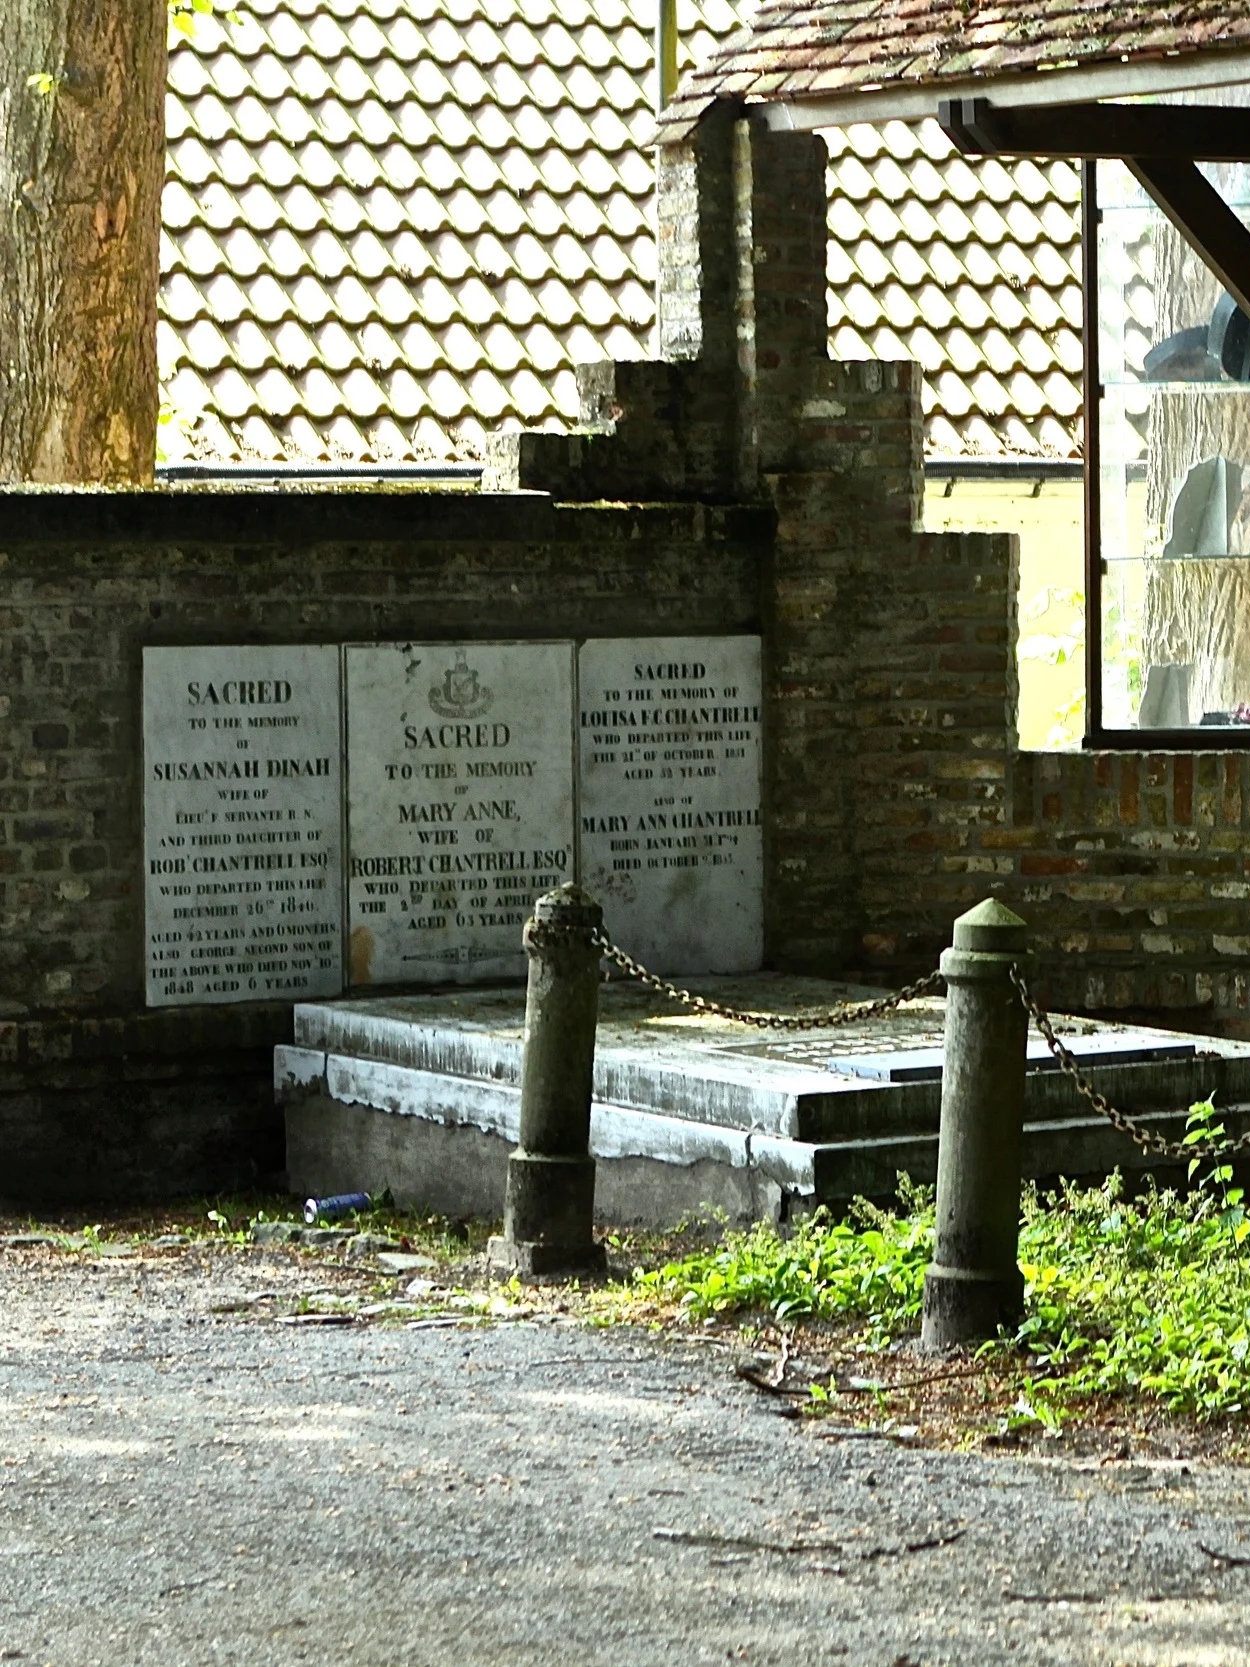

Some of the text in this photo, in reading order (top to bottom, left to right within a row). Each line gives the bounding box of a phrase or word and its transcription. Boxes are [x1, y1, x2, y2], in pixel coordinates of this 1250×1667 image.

[634, 662, 706, 680] SACRED
[187, 680, 293, 706] SACRED
[603, 687, 739, 702] TO THE MEMORY OF
[188, 716, 300, 730] TO THE MEMORY
[581, 707, 759, 728] LOUISA CHANTRELL
[236, 739, 250, 749] OF
[404, 723, 510, 749] SACRED
[593, 730, 750, 745] WHO DEPARTED THIS LIFE
[592, 752, 616, 763] THE
[643, 751, 658, 761] OF
[153, 758, 330, 782] SUSANNAH DINAH
[385, 761, 537, 781] TO THE MEMORY
[623, 768, 653, 780] AGED
[218, 789, 269, 800] WIFE OF
[454, 785, 469, 795] OF
[654, 796, 693, 806] ALSO OF
[225, 810, 283, 823] SERVANTE
[399, 800, 521, 824] MARY ANNE,
[582, 810, 759, 834] MARY ANN CHANTRELL
[160, 830, 322, 847] AND THIRD DAUGHTER OF
[417, 828, 494, 845] WIFE OF
[610, 839, 639, 851] BORN
[645, 836, 697, 850] JANUARY
[193, 853, 296, 872] CHANTRELL
[350, 851, 529, 878] ROBERT CHANTRELL
[613, 858, 641, 871] DIED
[647, 855, 698, 868] OCTOBER
[160, 878, 327, 896] WHO DEPARTED THIS LIFE
[364, 875, 560, 895] WHO DEPARTED THIS LIFE
[174, 905, 238, 919] DECEMBER
[359, 895, 536, 913] THE DAY OF APRIL
[408, 916, 446, 929] AGED
[479, 913, 523, 926] YEARS
[151, 932, 182, 943] AGED
[204, 928, 246, 940] YEARS
[251, 926, 274, 938] AND
[152, 950, 180, 960] ALSO
[245, 943, 288, 956] SECOND
[293, 942, 313, 953] SON
[318, 940, 333, 951] OF
[152, 960, 288, 978] THE ABOVE WHO DIED
[204, 981, 239, 993] AGED
[266, 976, 308, 989] YEARS
